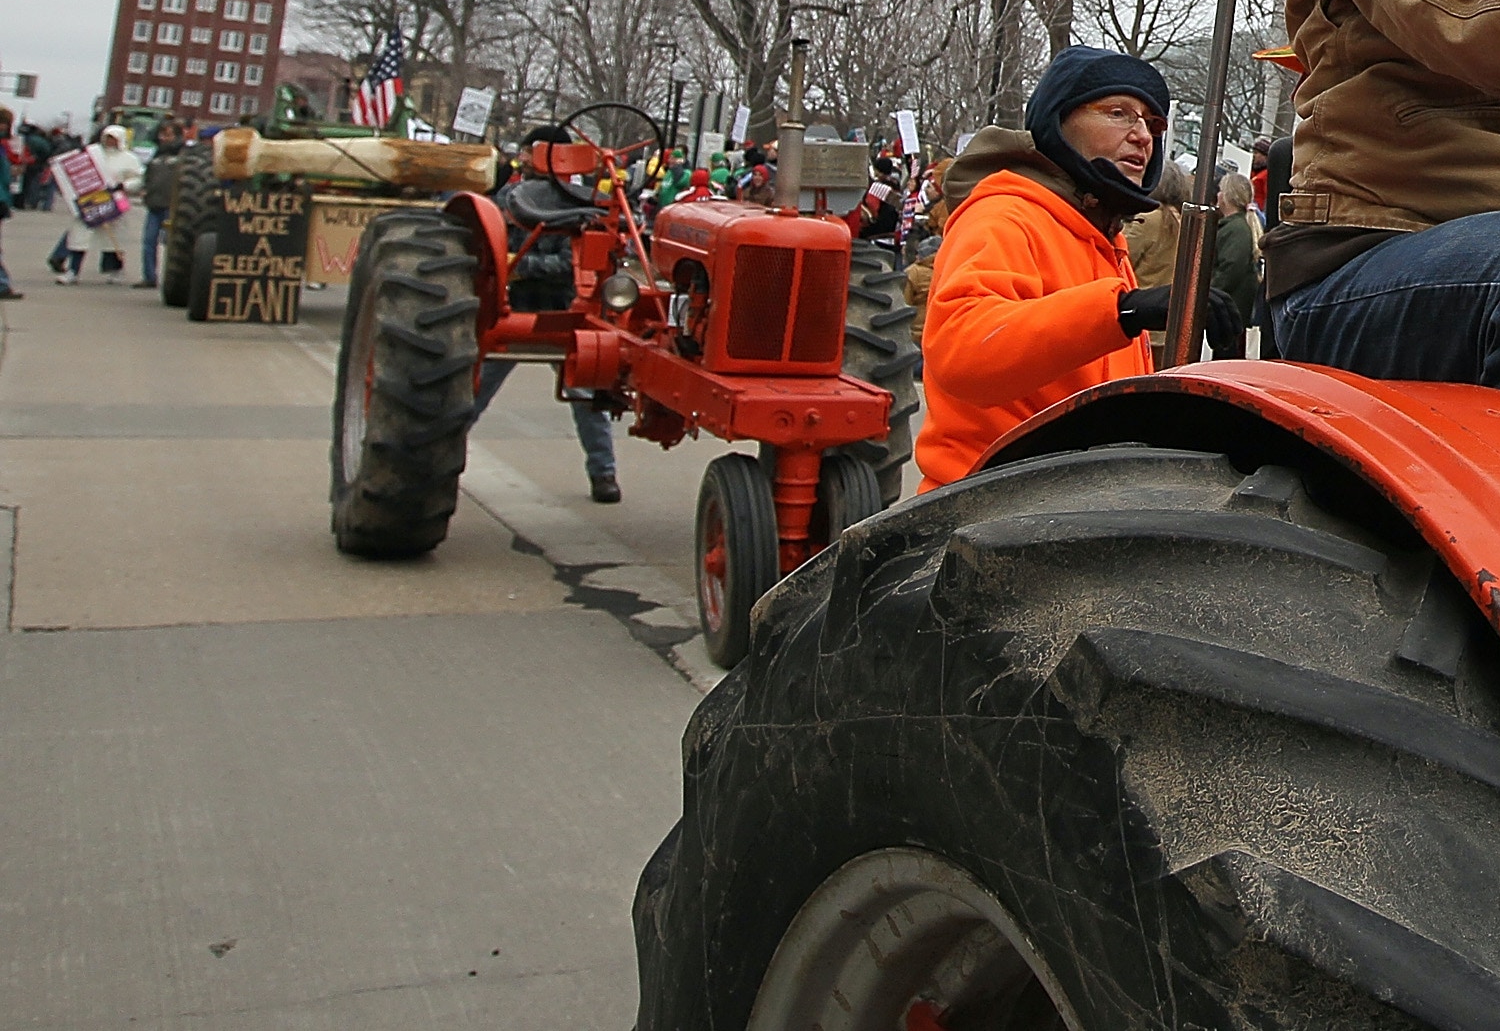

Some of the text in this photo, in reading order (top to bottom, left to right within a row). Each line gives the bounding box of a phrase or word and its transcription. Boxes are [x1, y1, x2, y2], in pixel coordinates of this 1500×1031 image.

[224, 190, 303, 214] WALKER
[238, 215, 290, 235] WOKE
[252, 235, 273, 256] A
[212, 254, 303, 279] SLEEPING
[207, 278, 300, 324] GIANT
